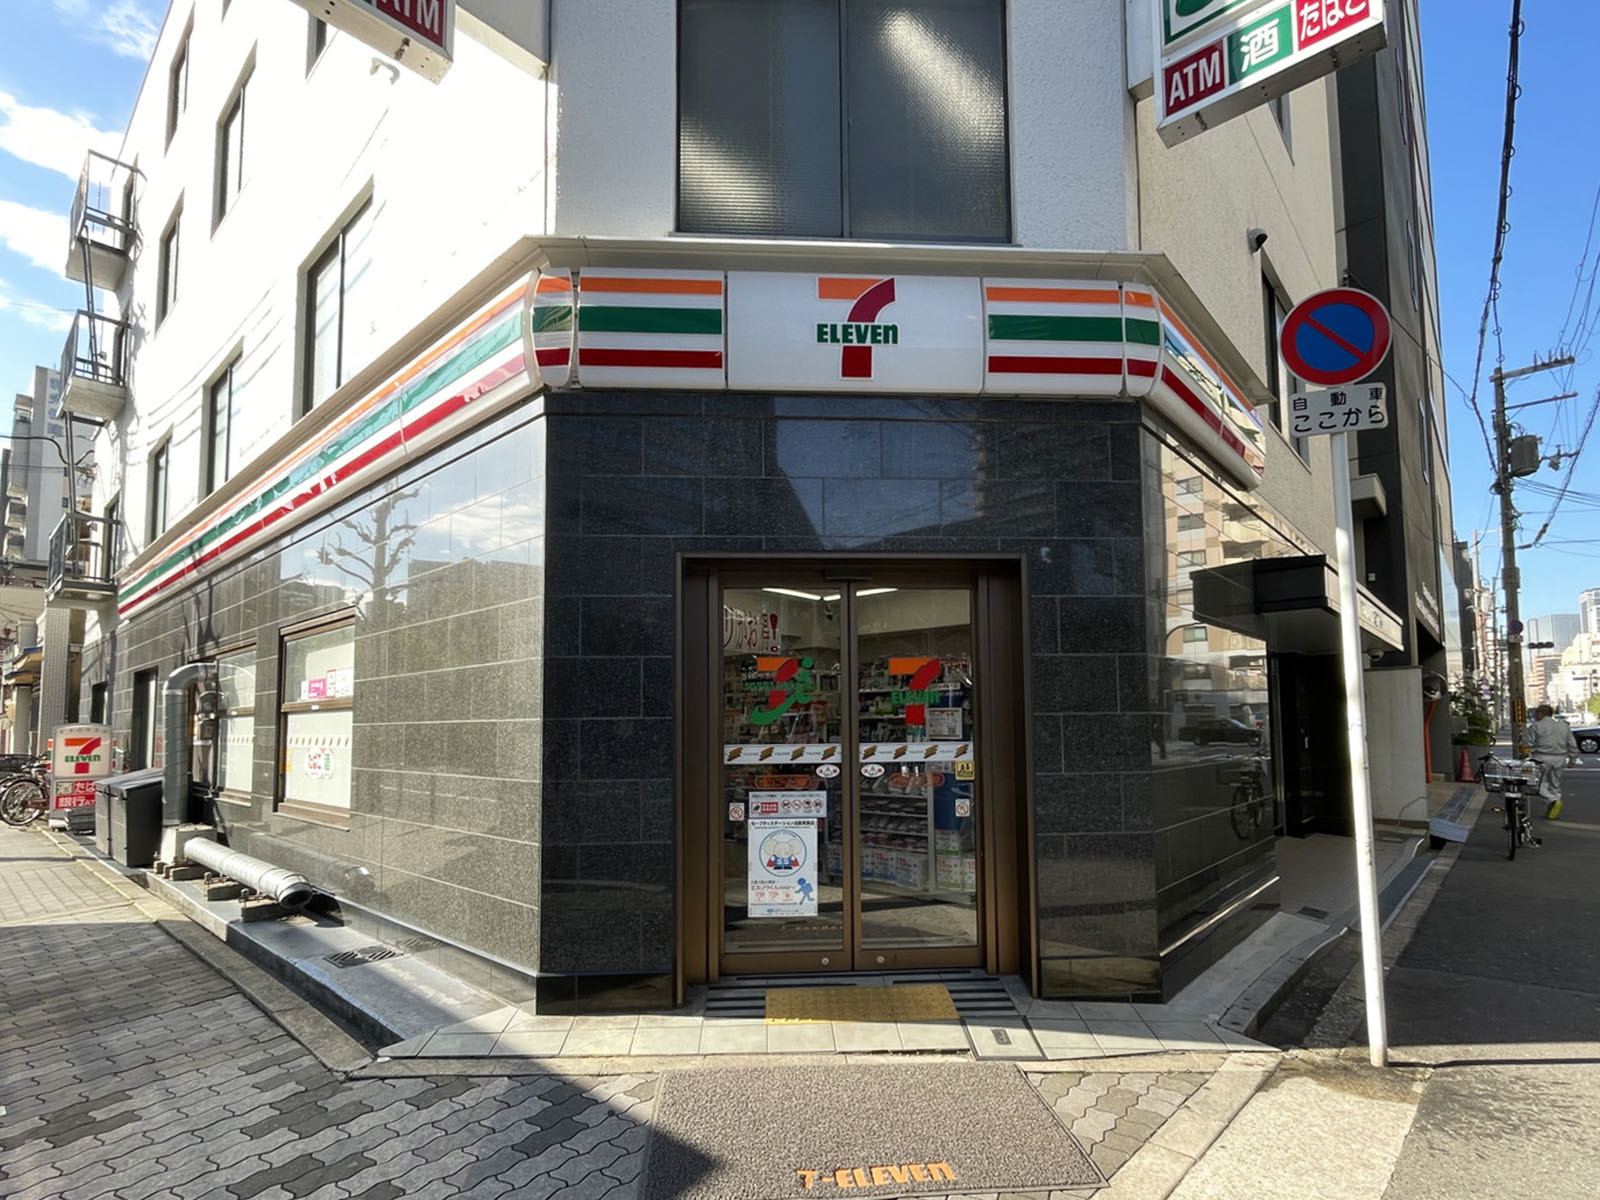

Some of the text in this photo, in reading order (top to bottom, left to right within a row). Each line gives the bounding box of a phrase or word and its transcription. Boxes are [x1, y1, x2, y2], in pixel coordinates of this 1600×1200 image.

[1240, 18, 1280, 73] 酒
[1168, 51, 1221, 107] ATM
[1293, 387, 1383, 411] 自動車
[1294, 404, 1385, 432] ここから
[74, 780, 96, 795] たば
